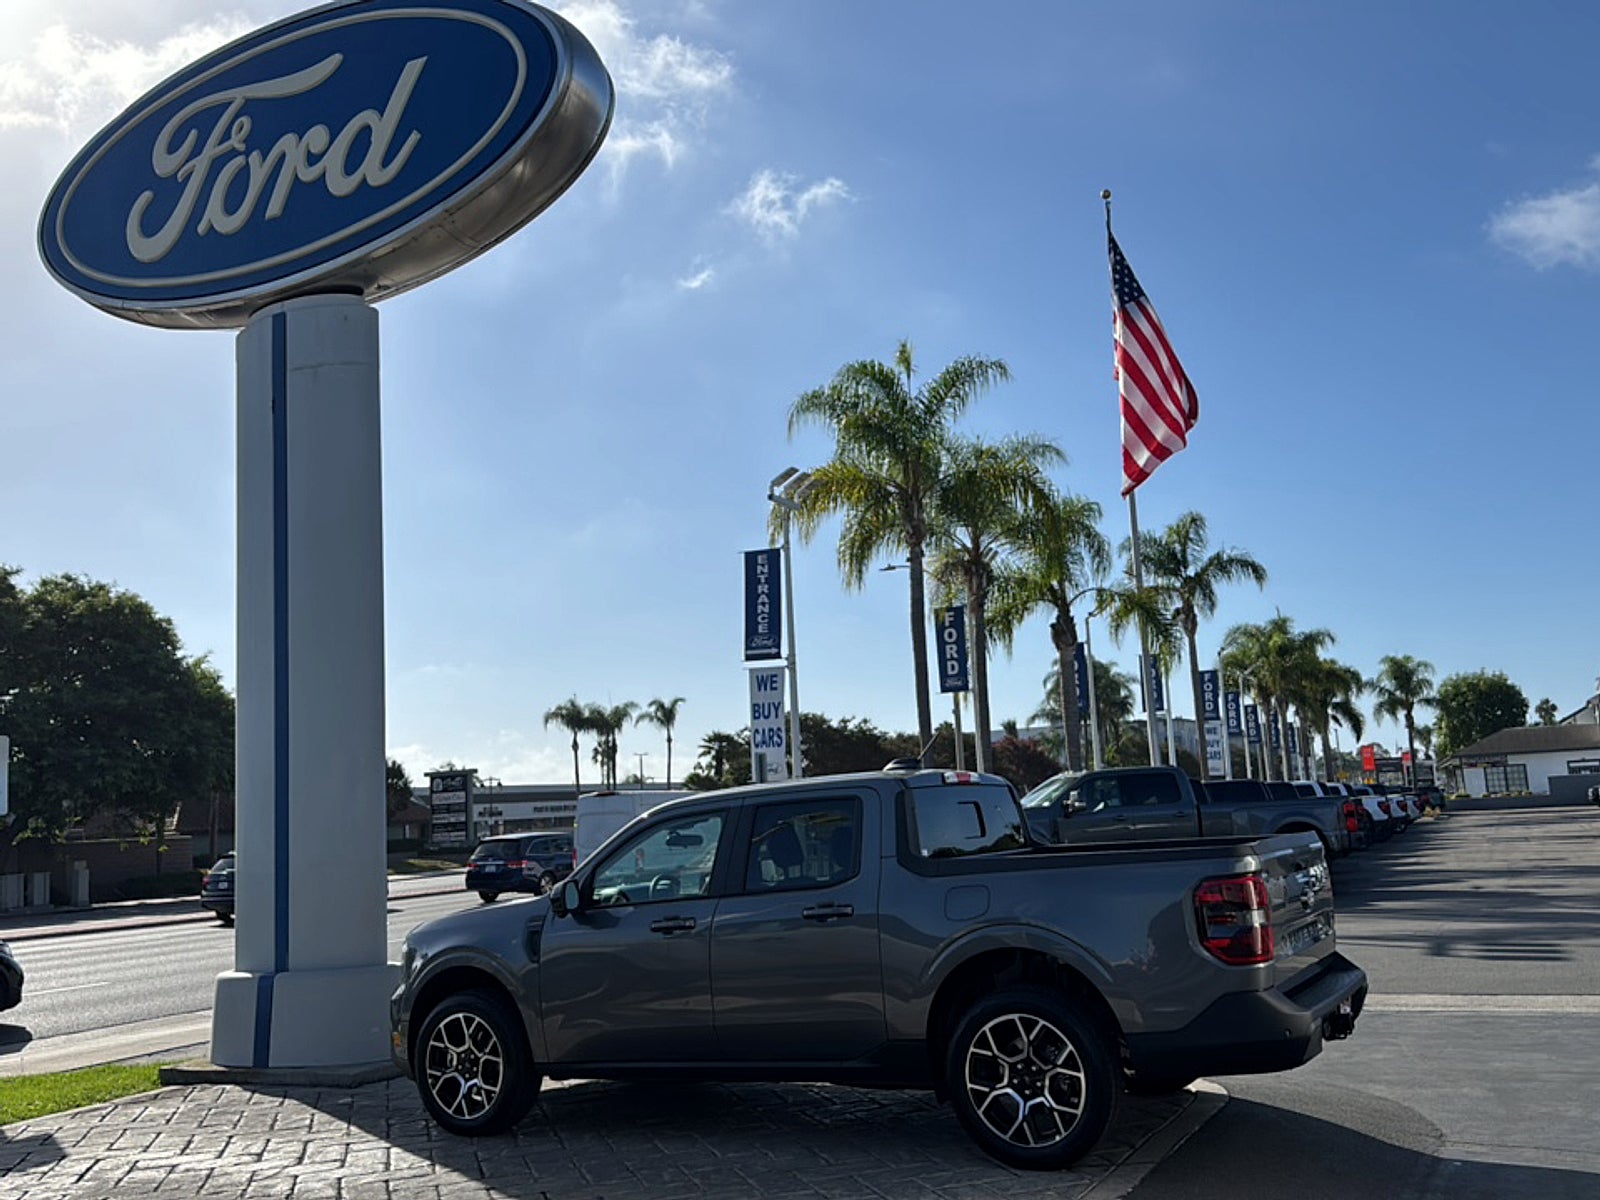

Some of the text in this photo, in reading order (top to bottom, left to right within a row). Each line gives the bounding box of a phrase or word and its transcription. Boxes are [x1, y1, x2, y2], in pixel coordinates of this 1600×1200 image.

[125, 52, 428, 263] Ford
[756, 554, 770, 634] ENTRANCE
[943, 611, 960, 676] FORD
[756, 673, 779, 692] WE
[1203, 673, 1215, 711] FORD
[753, 702, 782, 721] BUY
[1227, 693, 1238, 727] FORD
[1247, 706, 1257, 736] FORD
[753, 727, 783, 749] CARS
[1207, 739, 1220, 748] UY
